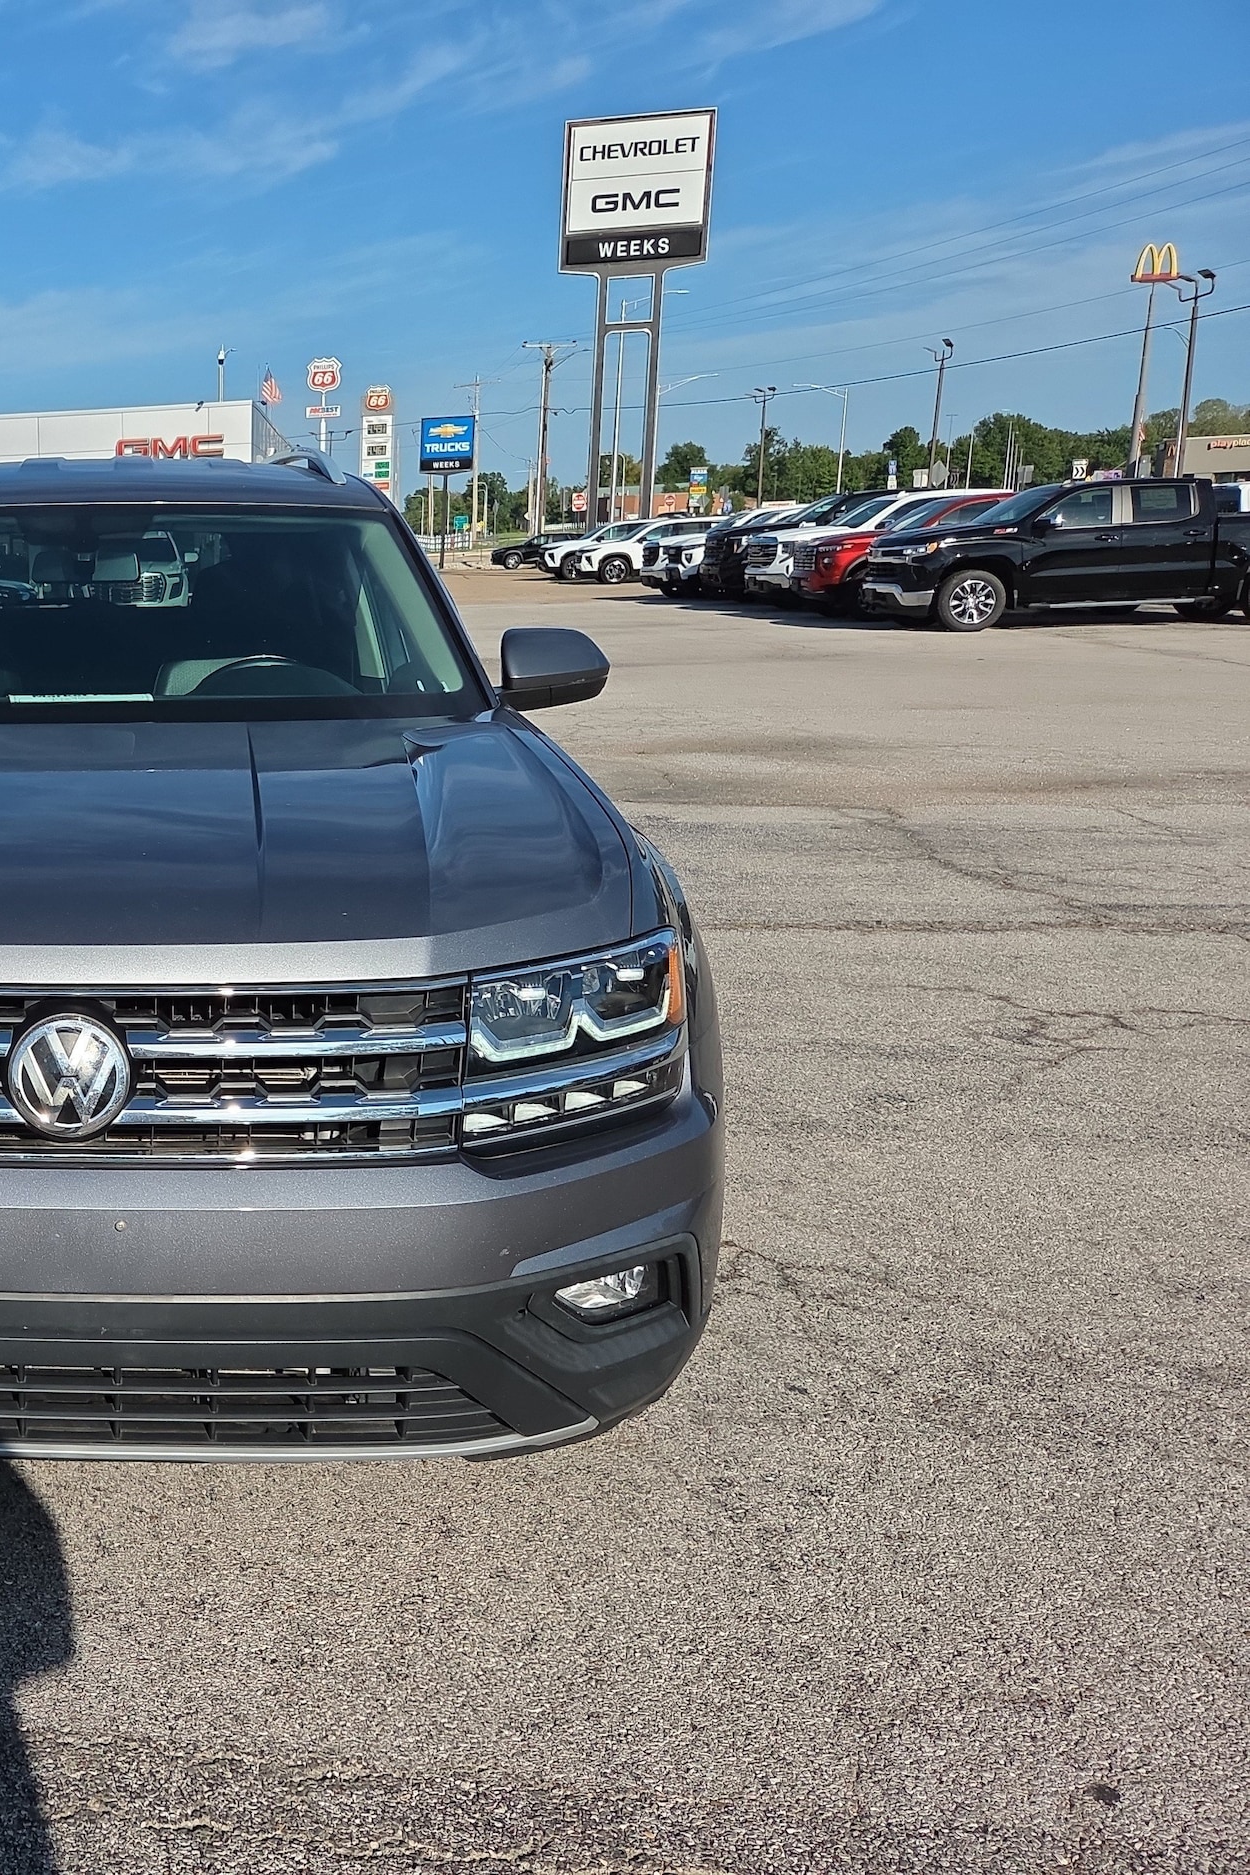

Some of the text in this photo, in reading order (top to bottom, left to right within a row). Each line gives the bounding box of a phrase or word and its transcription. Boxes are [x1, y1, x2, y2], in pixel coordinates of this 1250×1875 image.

[579, 136, 700, 161] CHEVROLET
[591, 188, 681, 213] GMC
[598, 237, 670, 258] WEEKS
[314, 372, 333, 385] 66
[369, 396, 386, 406] 66
[115, 433, 225, 458] GMC
[424, 442, 470, 453] TRUCKS
[432, 461, 460, 469] WEEKS
